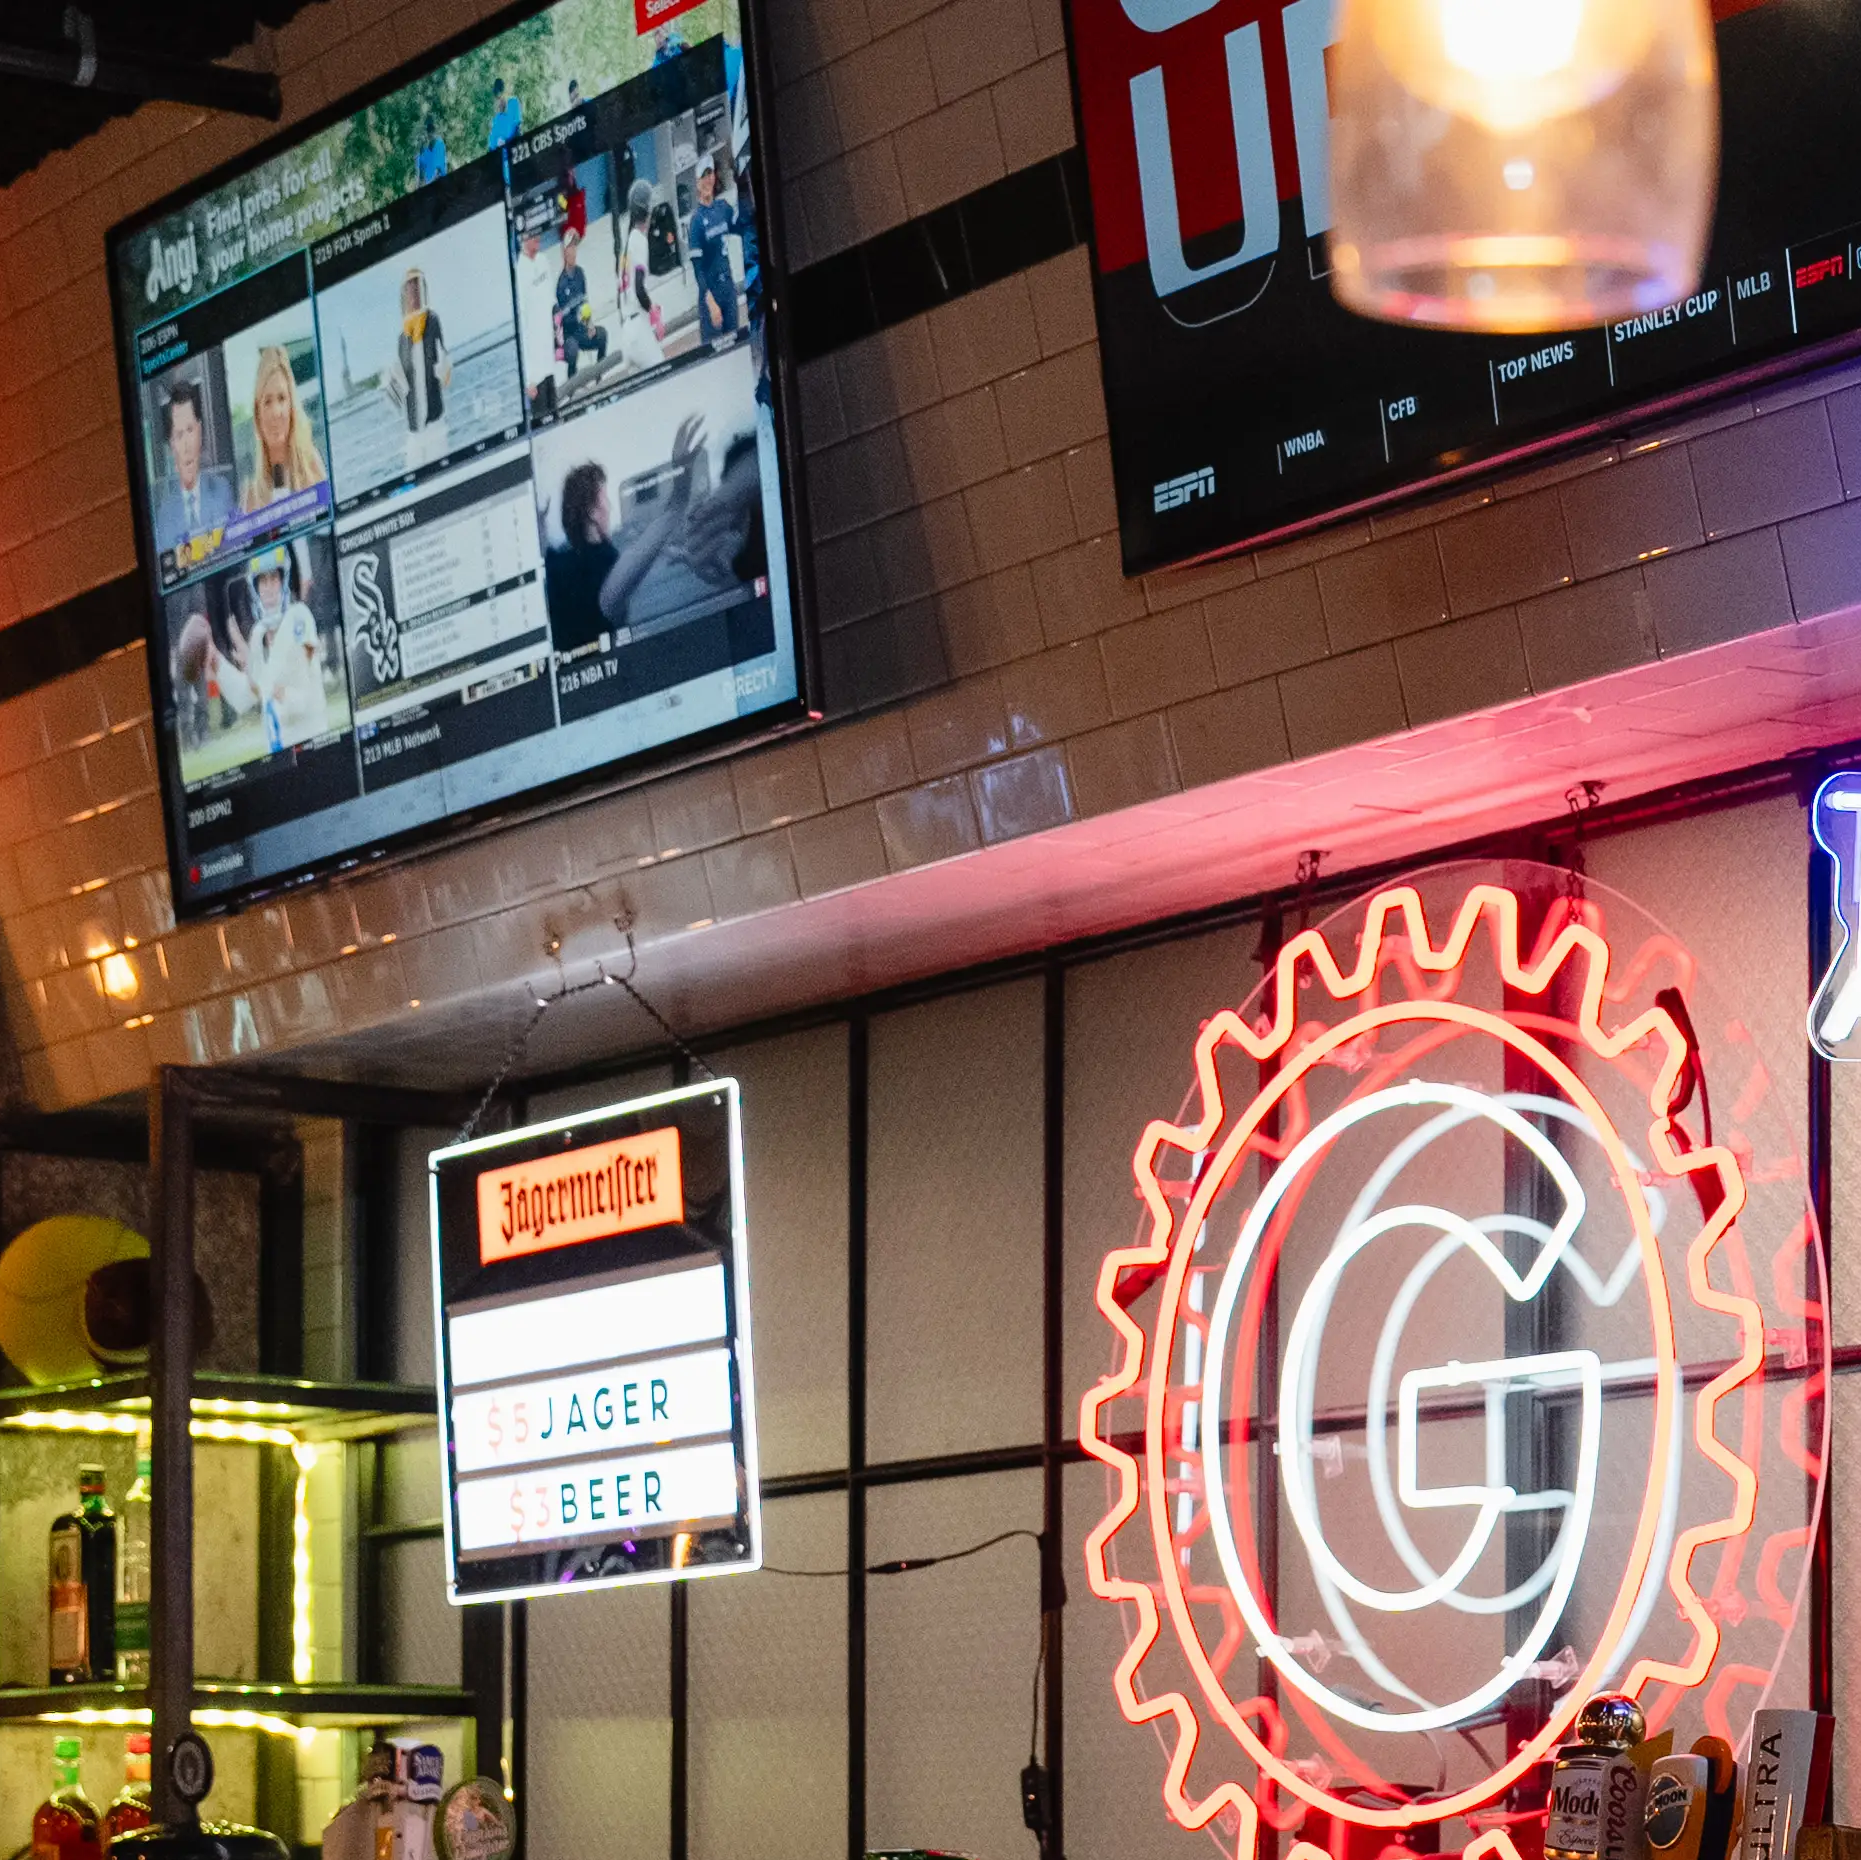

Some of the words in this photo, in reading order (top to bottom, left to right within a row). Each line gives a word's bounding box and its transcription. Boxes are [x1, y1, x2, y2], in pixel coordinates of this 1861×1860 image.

[533, 130, 552, 154] CBS
[555, 114, 587, 145] Sports
[207, 196, 242, 239] Find
[243, 184, 281, 224] pros
[282, 168, 307, 198] for
[311, 149, 333, 190] all
[208, 238, 247, 284] your
[248, 213, 294, 256] home
[296, 176, 366, 235] projects
[334, 233, 353, 259] FOX
[354, 218, 382, 251] Sports
[145, 222, 199, 303] Angi
[1795, 254, 1843, 289] ESPN
[1737, 271, 1772, 302] MLB
[1614, 302, 1682, 344] STANLEY
[1684, 289, 1719, 320] CUP
[1497, 353, 1528, 385] TOP
[1529, 340, 1575, 374] NEWS
[1387, 395, 1418, 423] CFB
[1283, 428, 1326, 459] WNBA
[1153, 465, 1216, 513] ESPN
[341, 531, 374, 553] CHICAGO
[560, 674, 580, 695] 216
[581, 664, 605, 688] NBA
[604, 658, 619, 678] TV
[383, 736, 403, 760] MLB
[403, 724, 441, 751] Network
[486, 1396, 530, 1457] $5
[540, 1377, 669, 1440] JAGER
[561, 1470, 663, 1526] BEER
[1604, 1763, 1638, 1841] Coors
